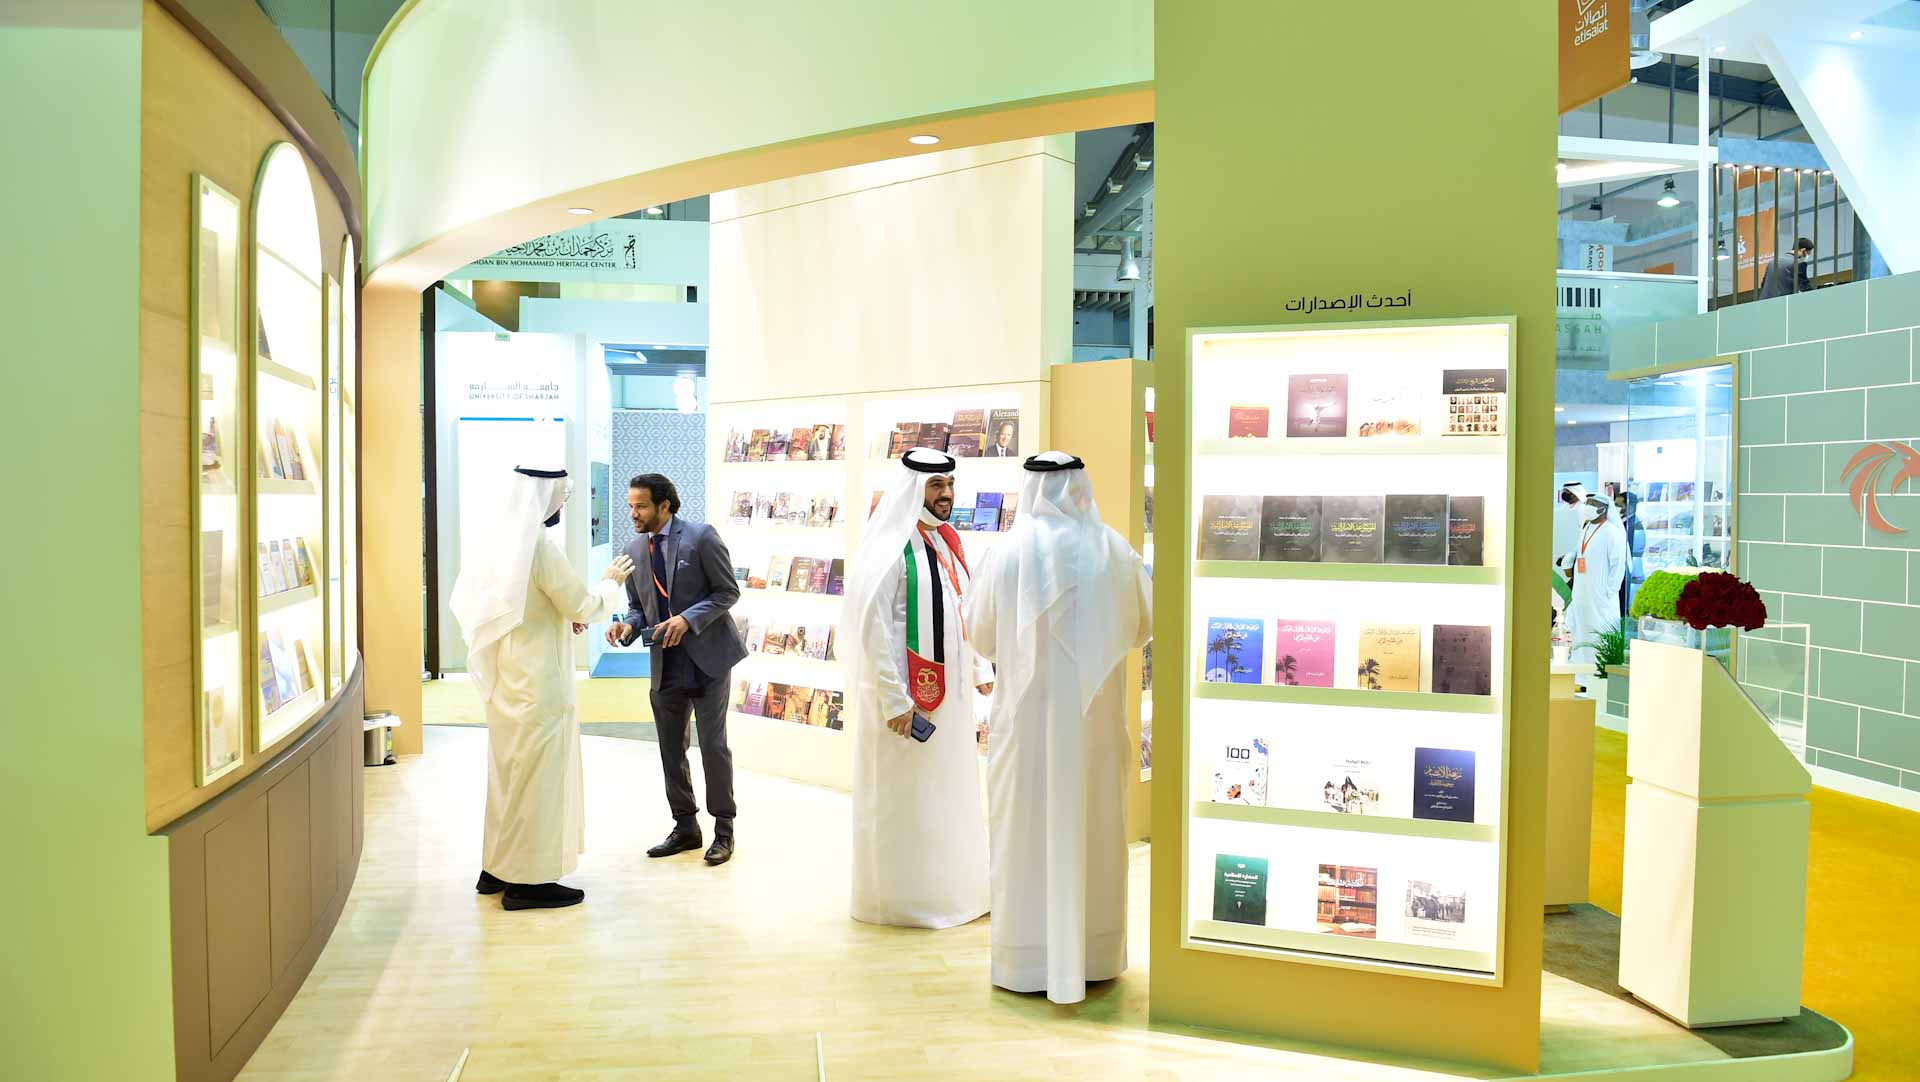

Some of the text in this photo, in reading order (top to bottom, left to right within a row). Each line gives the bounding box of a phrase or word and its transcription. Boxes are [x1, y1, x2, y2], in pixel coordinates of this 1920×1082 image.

[1574, 19, 1608, 46] etisalat
[590, 261, 616, 269] CENTER
[1285, 288, 1412, 314] أحدث الإصدارات
[993, 409, 1019, 417] Alexand
[1226, 746, 1250, 759] 100
